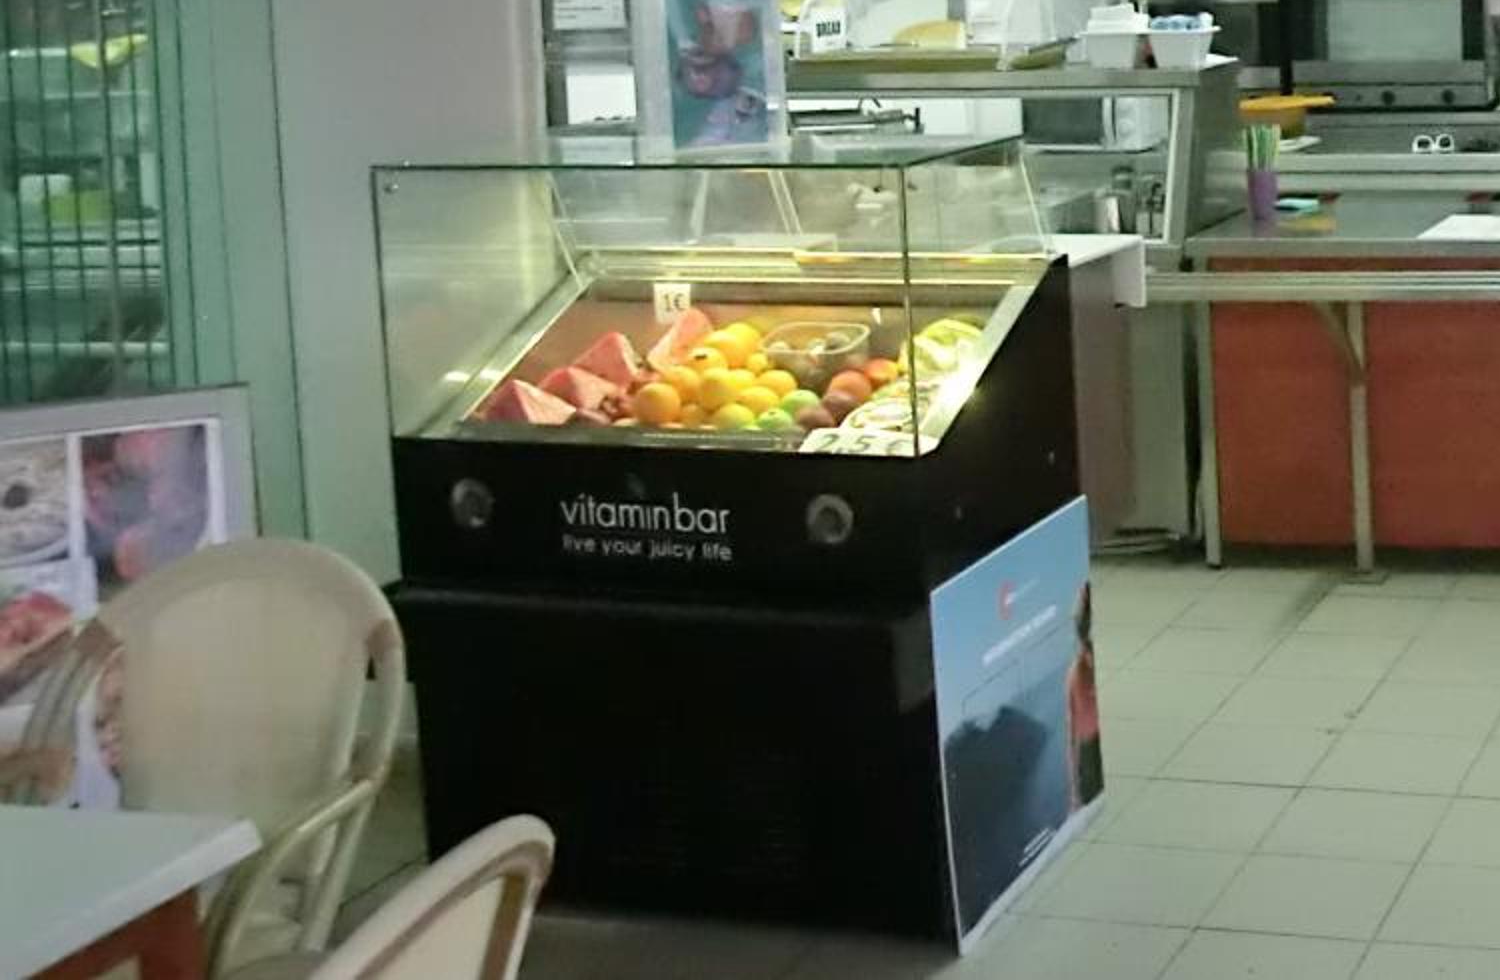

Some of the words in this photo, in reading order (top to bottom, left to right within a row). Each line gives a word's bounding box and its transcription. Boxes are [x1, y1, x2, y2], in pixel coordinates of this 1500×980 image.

[562, 534, 597, 553] live
[601, 539, 643, 557] your
[648, 538, 696, 561] juicy
[702, 542, 733, 562] life
